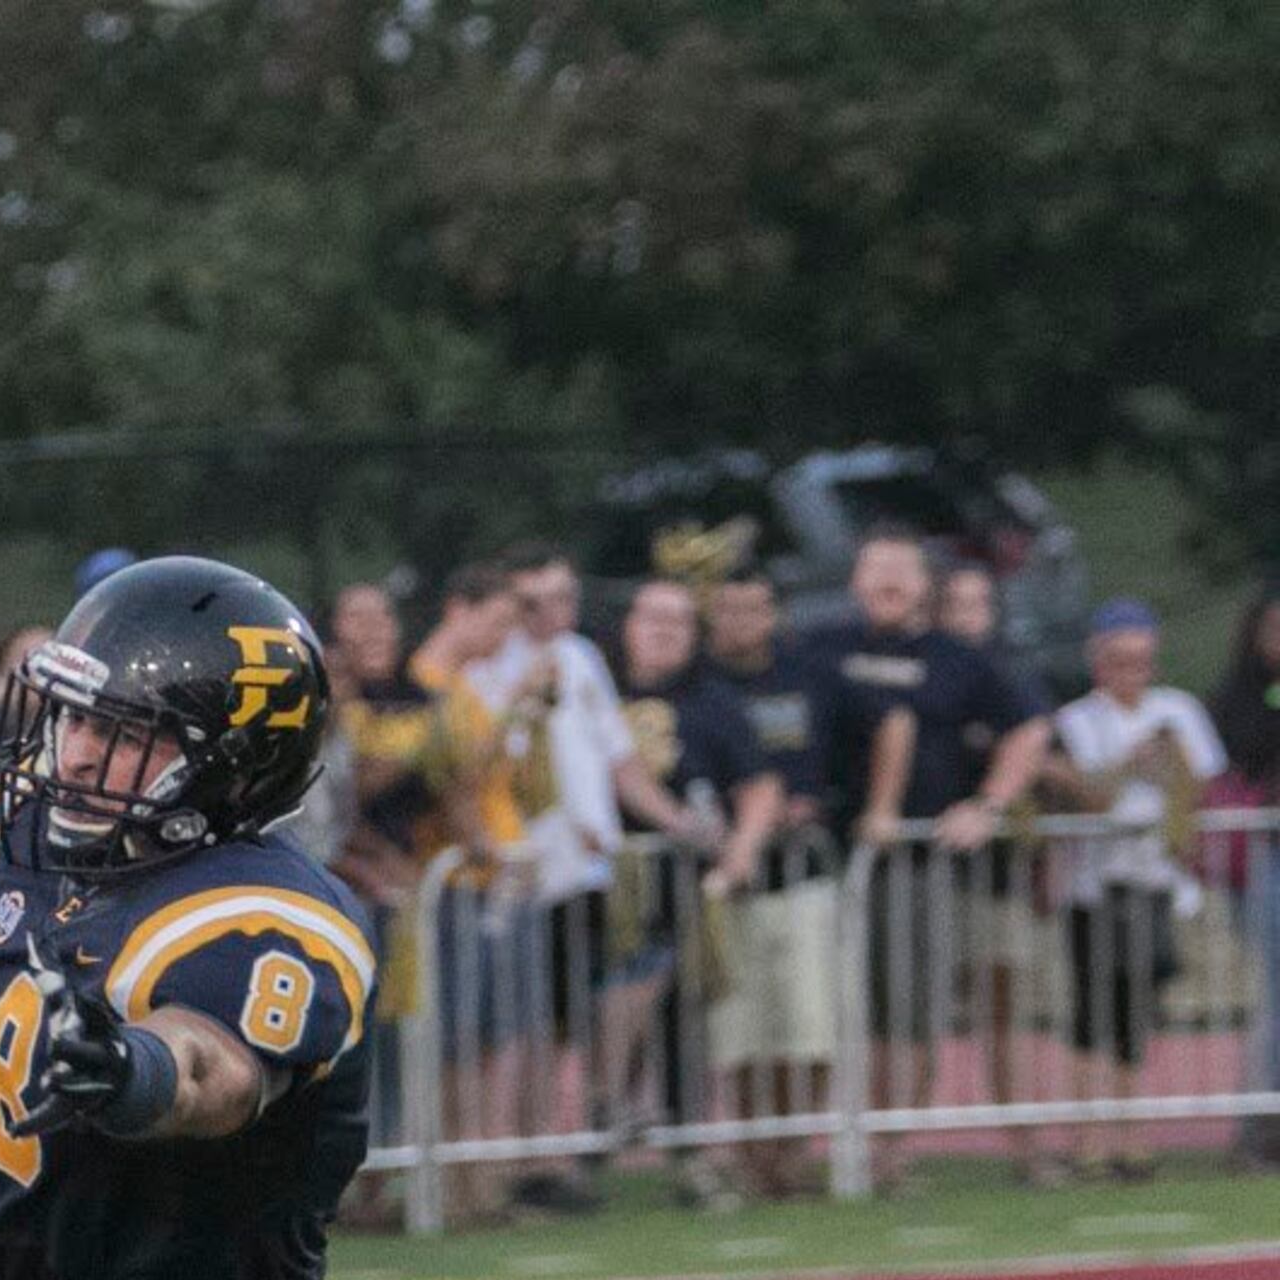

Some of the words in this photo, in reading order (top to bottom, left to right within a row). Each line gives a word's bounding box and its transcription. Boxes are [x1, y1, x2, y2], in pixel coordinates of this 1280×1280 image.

[227, 625, 310, 729] E
[54, 896, 83, 923] E
[239, 949, 314, 1055] 8
